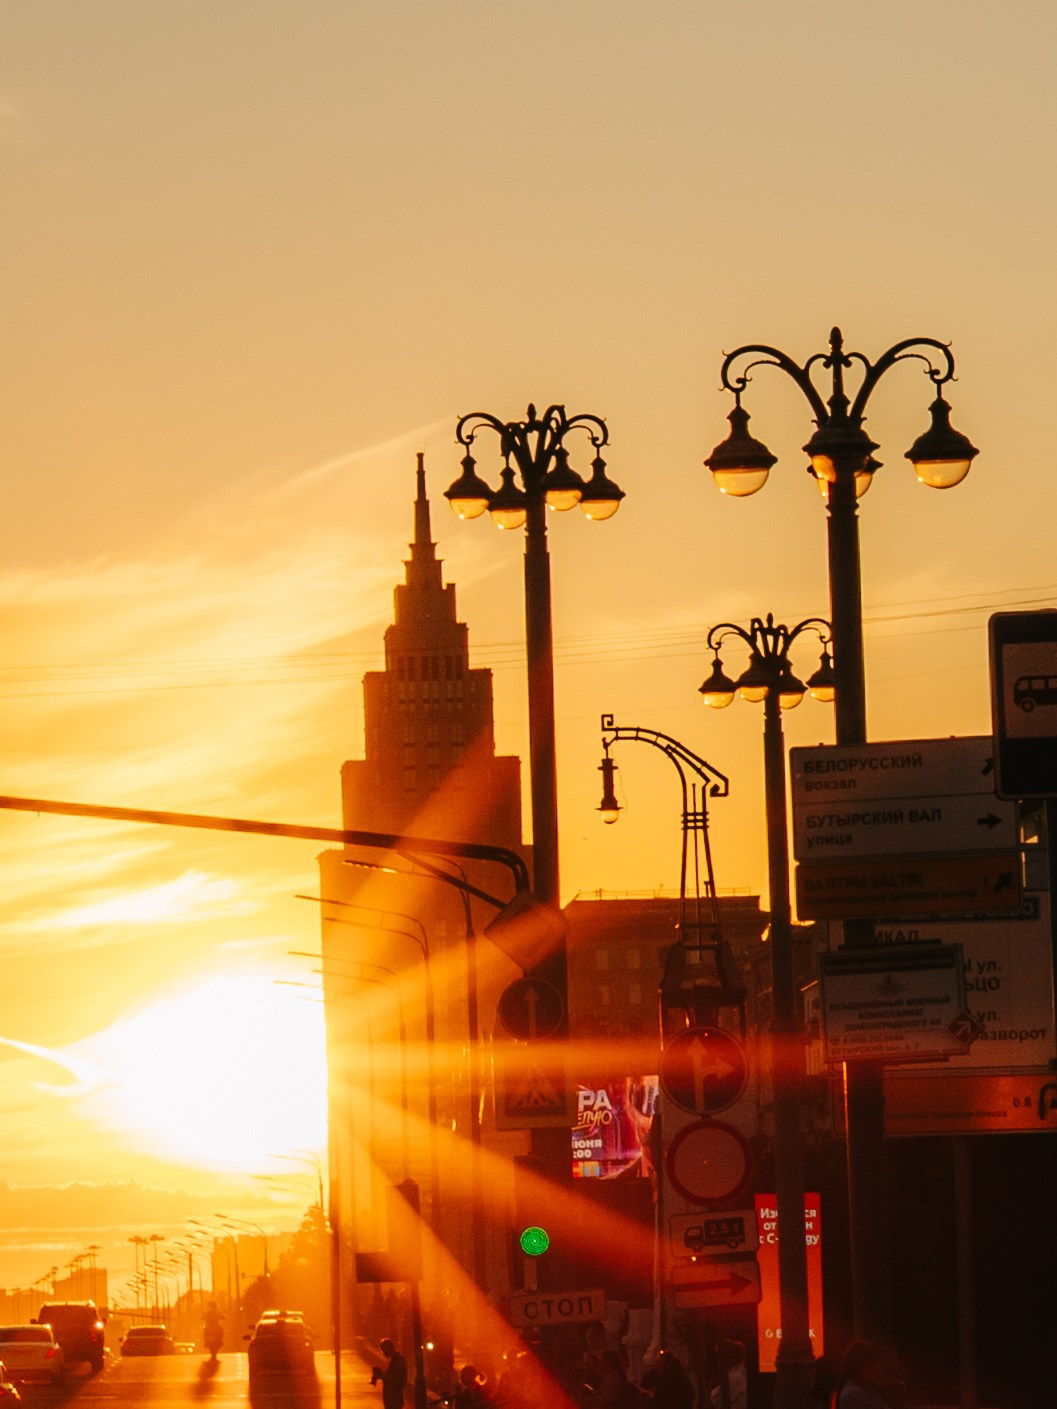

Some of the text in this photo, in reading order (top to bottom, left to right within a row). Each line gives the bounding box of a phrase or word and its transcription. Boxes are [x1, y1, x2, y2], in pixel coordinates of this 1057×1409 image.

[804, 752, 922, 774] БЕЛОРУССКИЙ
[805, 779, 857, 792] вокзал
[806, 809, 942, 829] БУТЫРСКИЙ ВАЛ
[806, 834, 853, 849] улица
[976, 1028, 1048, 1042] азворот
[577, 1089, 613, 1112] РА
[524, 1296, 593, 1319] СТОП
